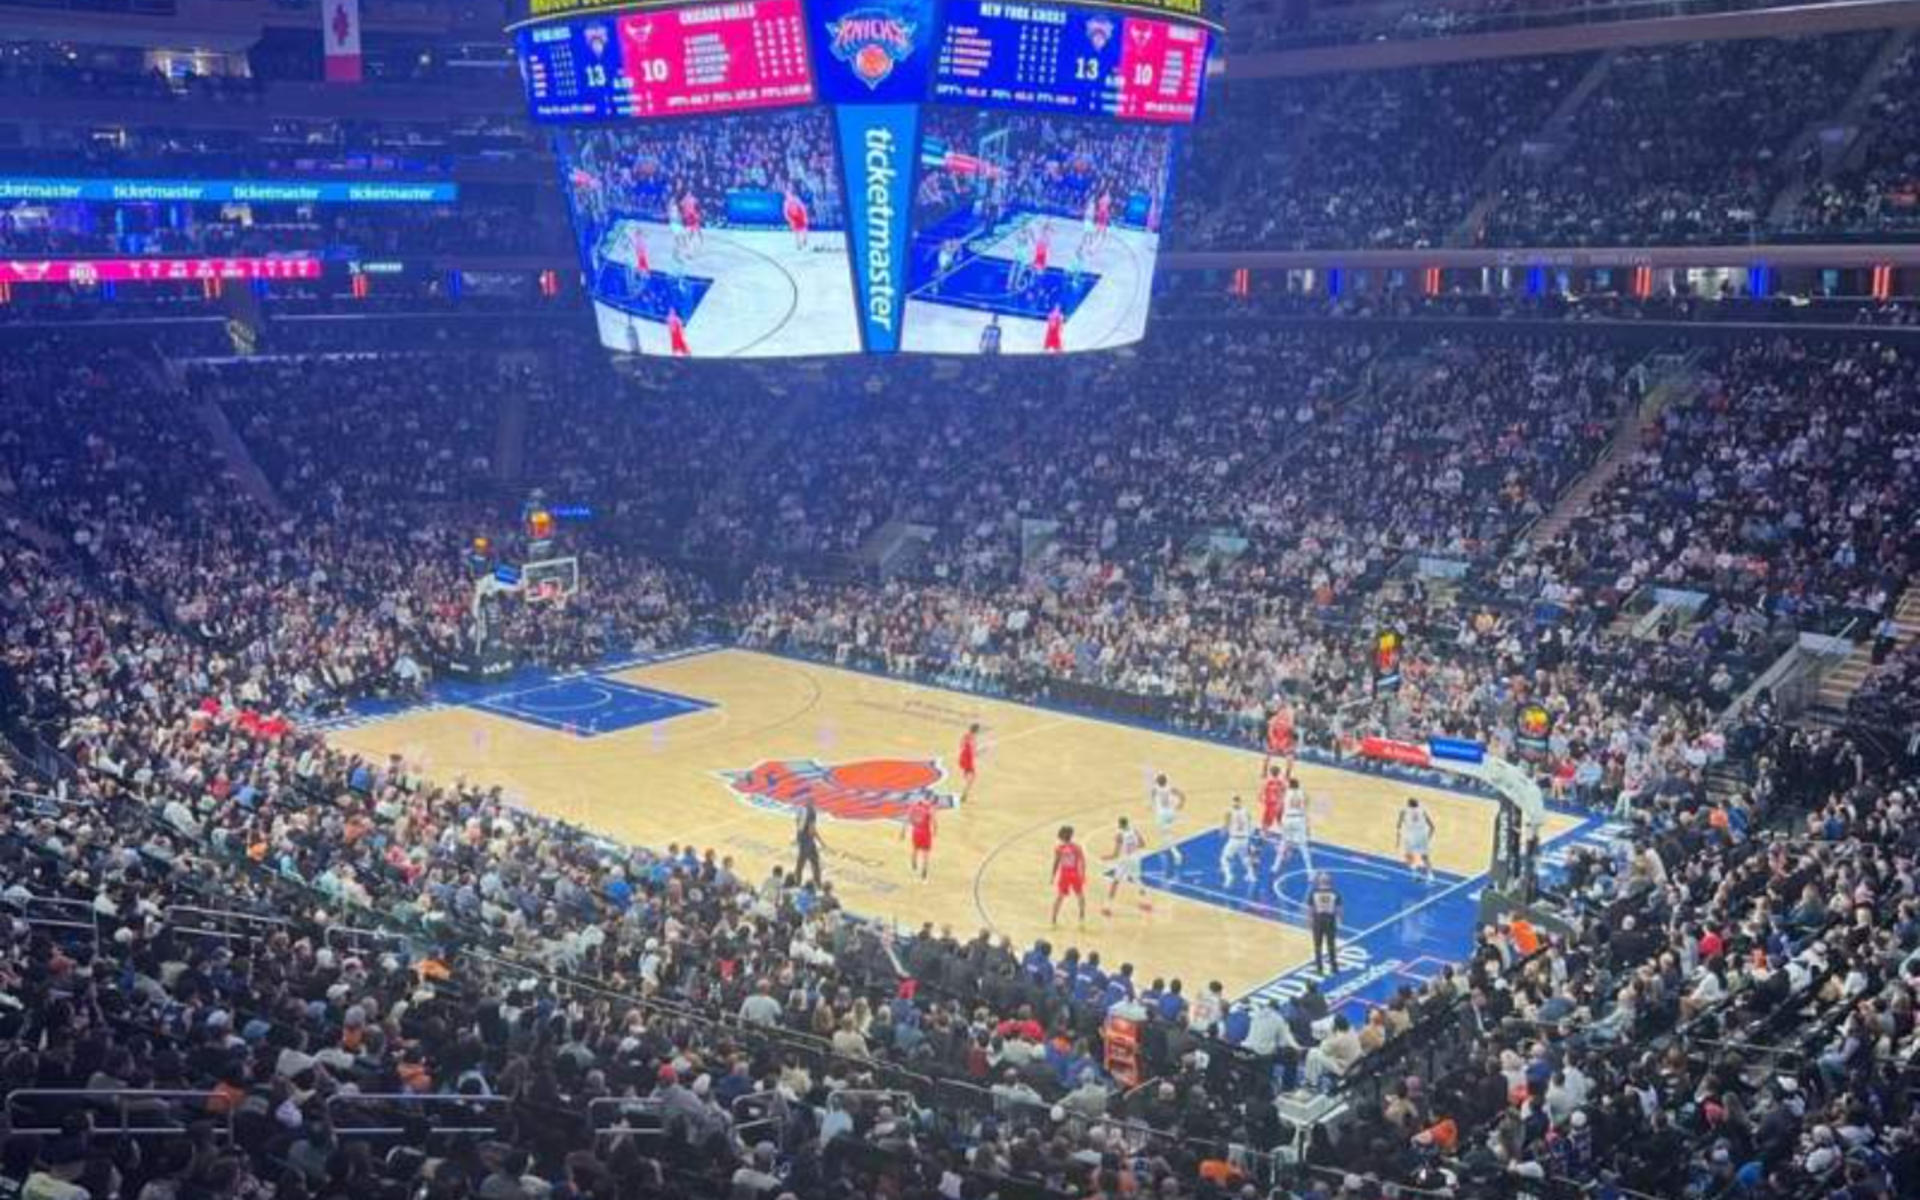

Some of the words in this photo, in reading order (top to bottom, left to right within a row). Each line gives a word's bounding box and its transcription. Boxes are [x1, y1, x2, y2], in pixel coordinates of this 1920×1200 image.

[586, 64, 606, 87] 13
[641, 58, 668, 82] 10
[1075, 57, 1098, 79] 13
[1134, 63, 1153, 86] 10
[865, 127, 897, 331] ticketmaster
